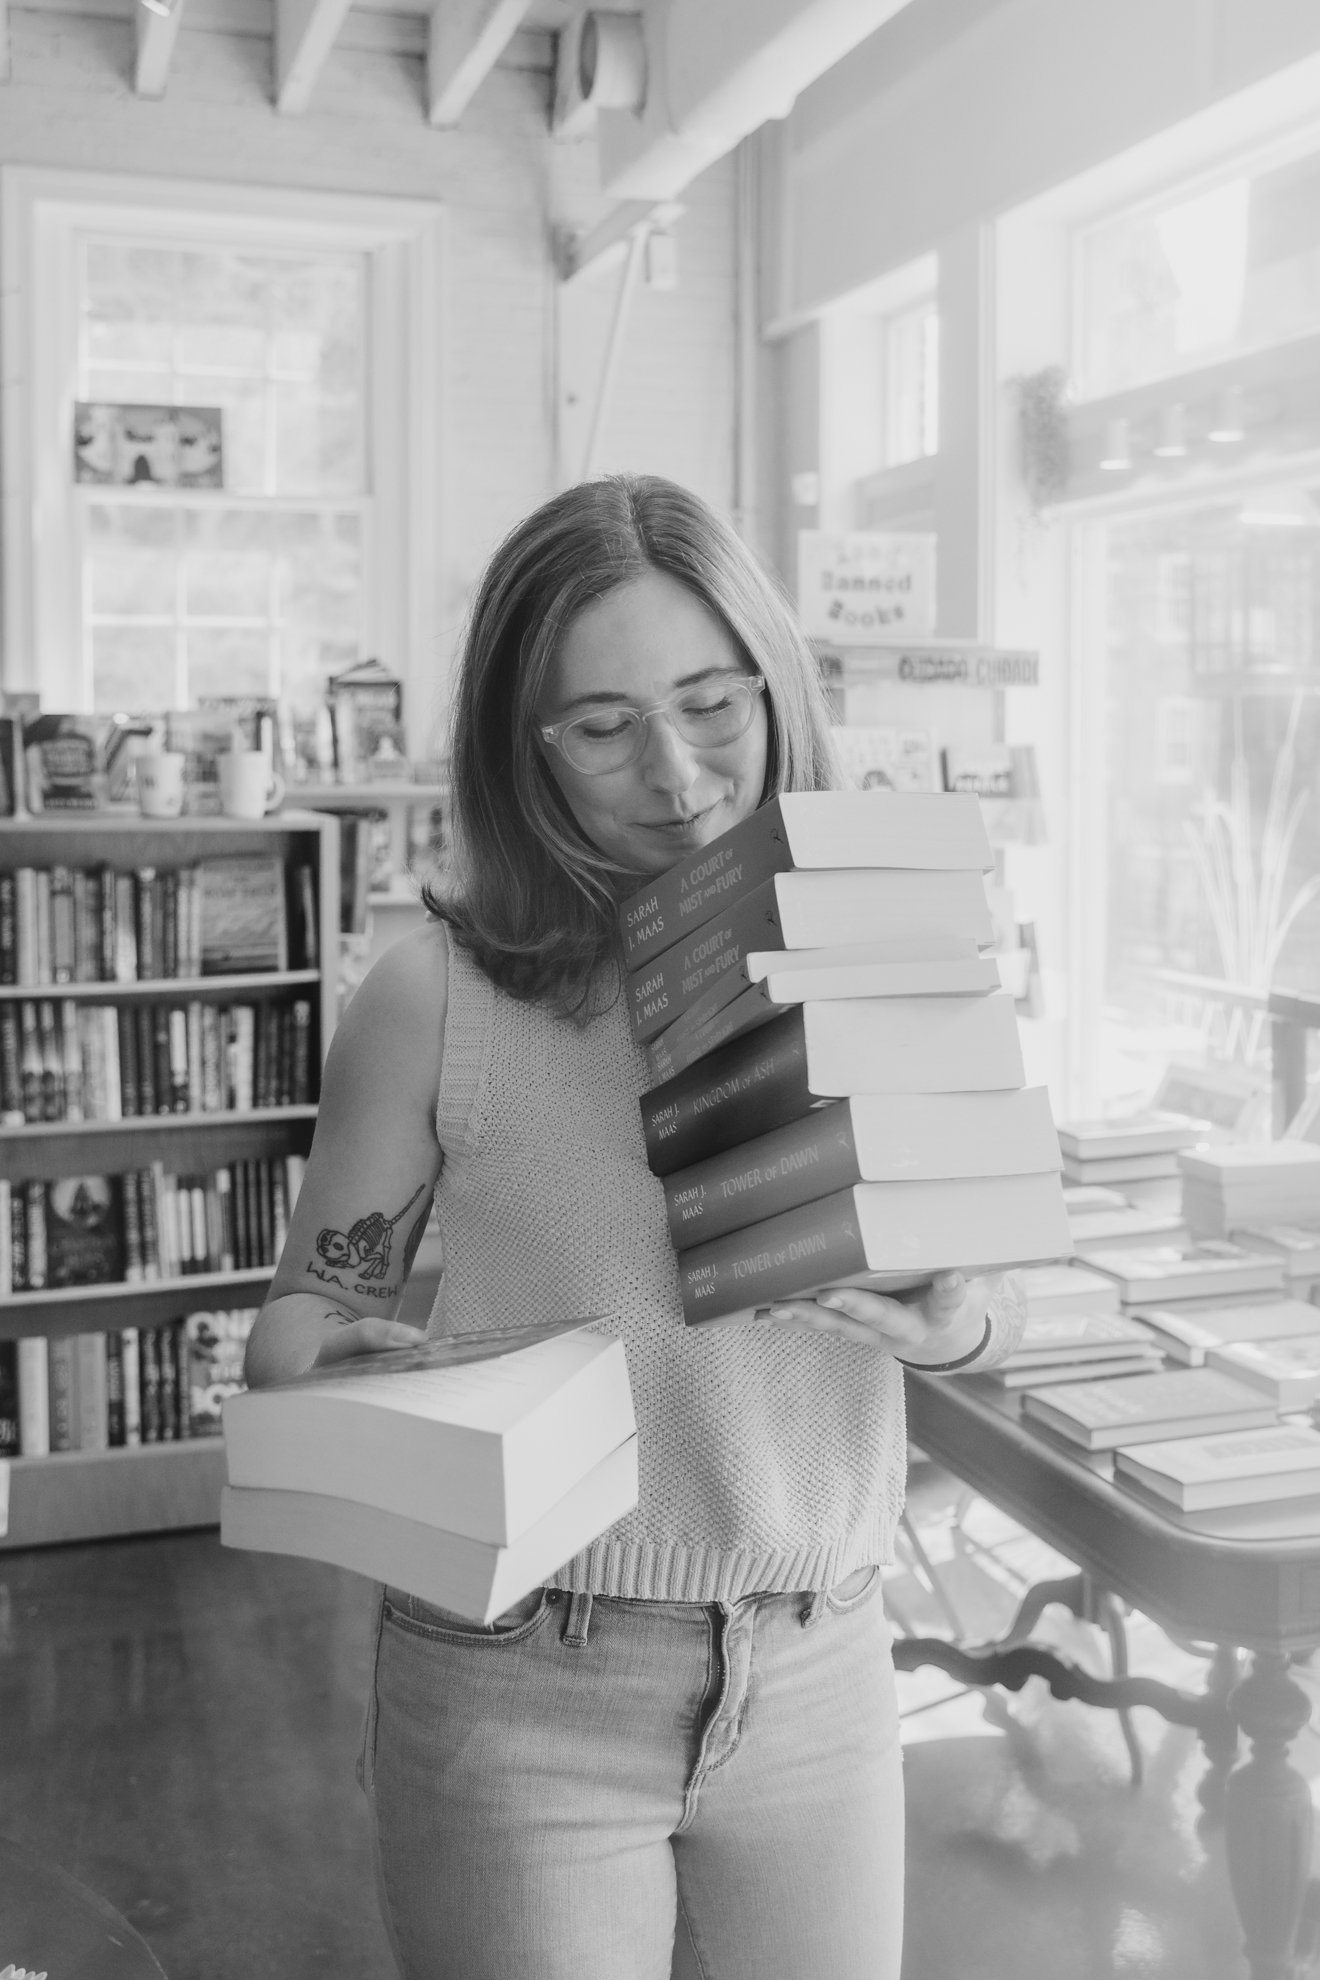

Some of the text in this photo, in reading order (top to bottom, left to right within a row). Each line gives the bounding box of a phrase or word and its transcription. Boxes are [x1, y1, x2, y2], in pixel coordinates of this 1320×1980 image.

[690, 851, 724, 885] COURT
[680, 890, 702, 917] MIST
[715, 864, 743, 893] FURY
[626, 896, 659, 928] SARAH
[637, 916, 664, 944] MAAS
[693, 930, 724, 963] COURT
[682, 968, 703, 995] MIST
[715, 944, 740, 973] FURY
[635, 972, 664, 1002] SARAH
[643, 992, 669, 1020] MAAS
[692, 1077, 741, 1115] KINGDOM
[753, 1057, 775, 1081] ASH
[651, 1105, 673, 1127] SARAH
[658, 1121, 678, 1140] MAAS
[720, 1168, 762, 1198] TOWER
[780, 1144, 820, 1175] DAWN
[674, 1186, 699, 1207] SARAH
[682, 1202, 704, 1221] MAAS
[732, 1252, 772, 1280] TOWER
[788, 1232, 828, 1262] DAWN
[687, 1266, 711, 1284] SARAH
[354, 1284, 398, 1298] CREW
[694, 1282, 716, 1299] MAAS
